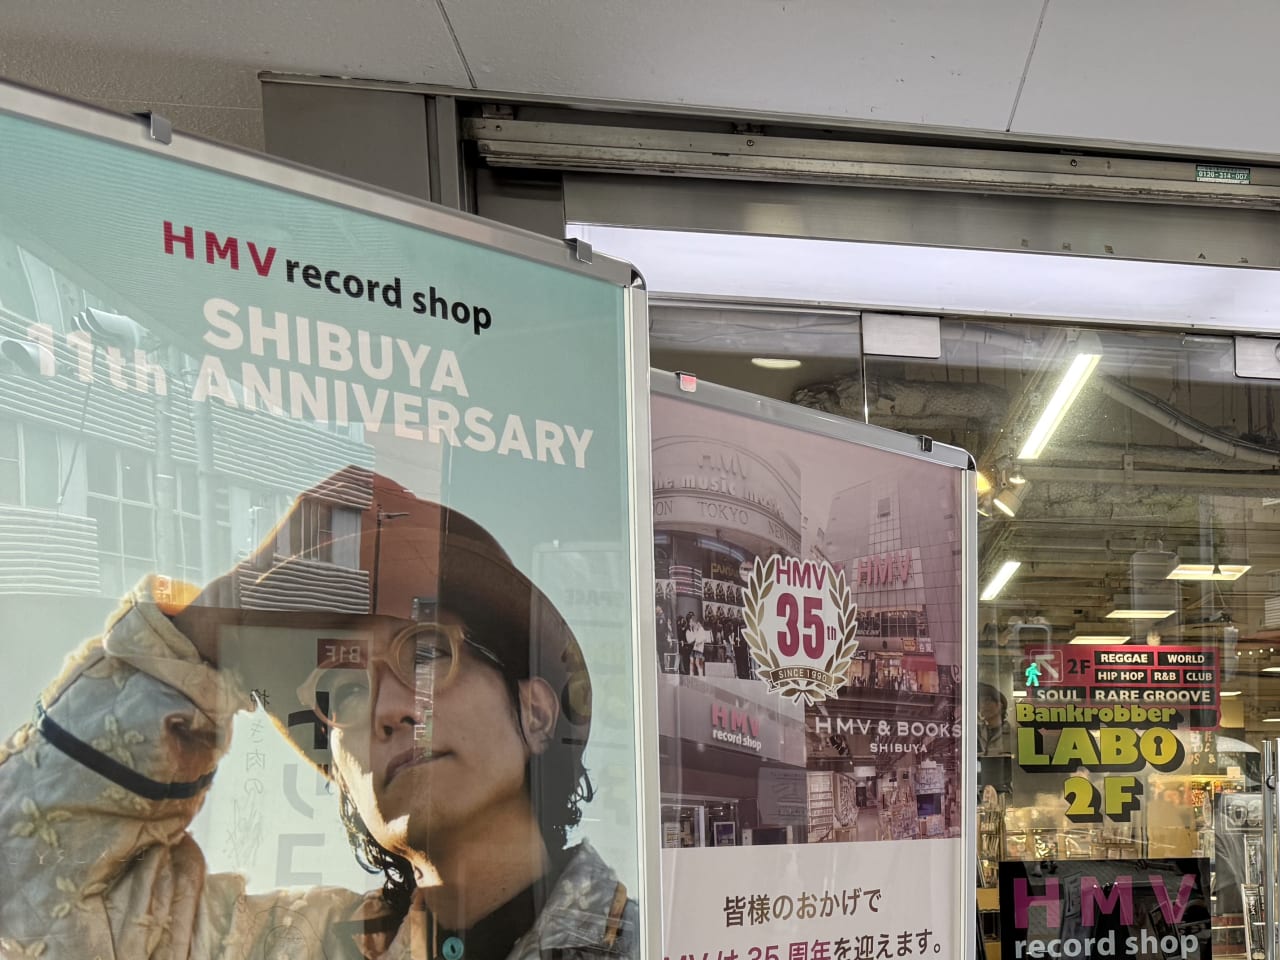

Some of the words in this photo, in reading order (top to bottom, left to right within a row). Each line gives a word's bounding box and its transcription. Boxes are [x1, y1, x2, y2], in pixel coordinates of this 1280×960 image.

[163, 220, 278, 277] HMV
[285, 256, 402, 309] record
[411, 287, 493, 335] shop
[203, 297, 471, 398] SHIBUYA
[25, 321, 168, 397] 11th
[192, 355, 595, 469] ANNIVERSARY
[776, 557, 826, 590] HMV
[1067, 659, 1092, 675] 2F
[1100, 653, 1148, 664] REGGAE
[1167, 654, 1205, 664] WORLD
[778, 669, 804, 679] SINCE
[806, 670, 827, 682] 1990
[1097, 671, 1119, 681] HIP
[1120, 671, 1145, 682] HOP
[1154, 671, 1177, 681] R&B
[1186, 672, 1213, 682] CLUB
[1036, 689, 1082, 701] SOUL
[1095, 690, 1140, 702] RARE
[1143, 690, 1211, 702] GROOVE
[711, 703, 760, 736] HMV
[815, 717, 871, 735] HMV
[878, 720, 890, 736] &
[897, 720, 962, 738] BOOKS
[1016, 703, 1179, 725] Bankrobber
[712, 729, 742, 745] record
[742, 737, 762, 751] shop
[870, 743, 928, 753] SHIBUYA
[1017, 726, 1180, 767] LABO
[1064, 775, 1140, 820] 2F
[723, 887, 882, 928] 皆様のおかげで
[1013, 873, 1197, 929] HMV
[1015, 930, 1116, 959] record
[1125, 928, 1199, 960] shop
